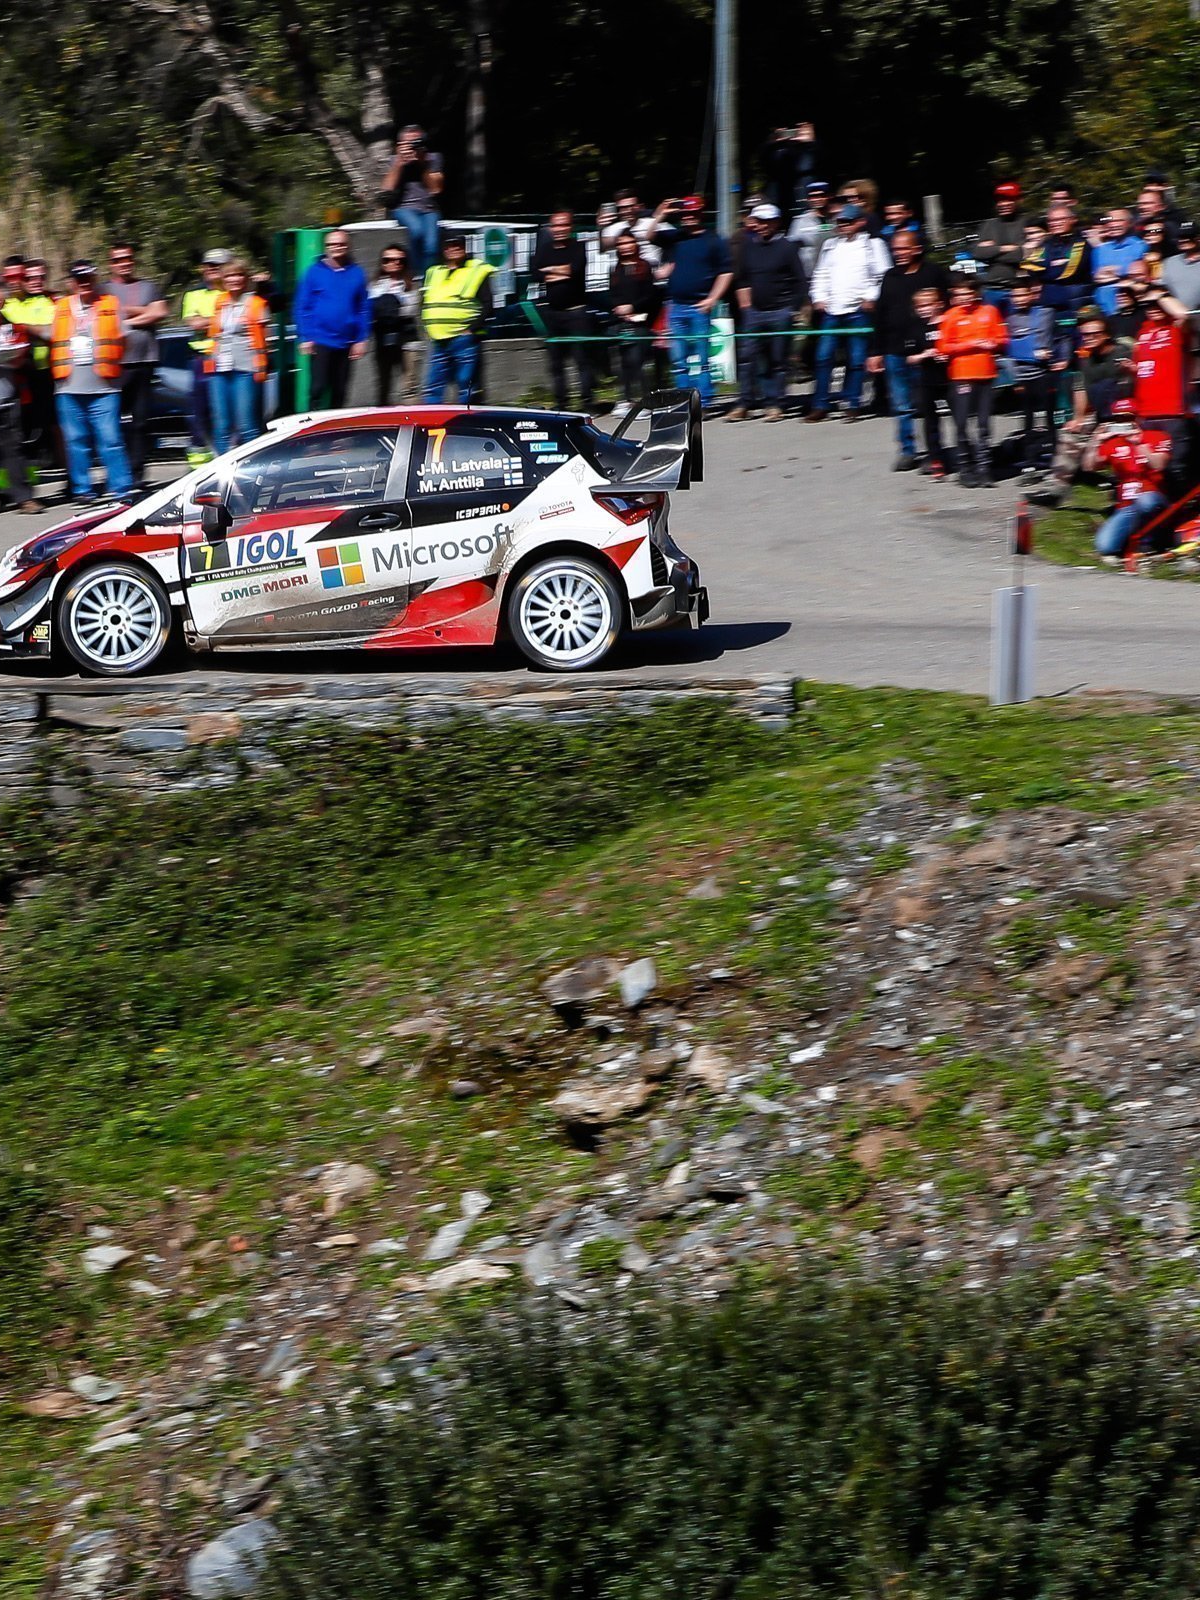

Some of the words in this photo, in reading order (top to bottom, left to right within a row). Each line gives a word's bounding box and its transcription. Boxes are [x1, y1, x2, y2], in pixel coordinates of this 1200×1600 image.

[427, 428, 446, 462] 7
[416, 461, 448, 477] J-M.
[451, 457, 503, 473] Latvala
[419, 481, 437, 493] M.
[440, 476, 485, 490] Anttila
[548, 500, 573, 511] TOYOTA
[200, 545, 214, 570] 7
[237, 530, 298, 566] IGOL
[371, 523, 514, 573] Microsoft
[221, 585, 261, 602] DMG
[263, 574, 309, 593] MORI
[320, 602, 358, 615] GAZOO
